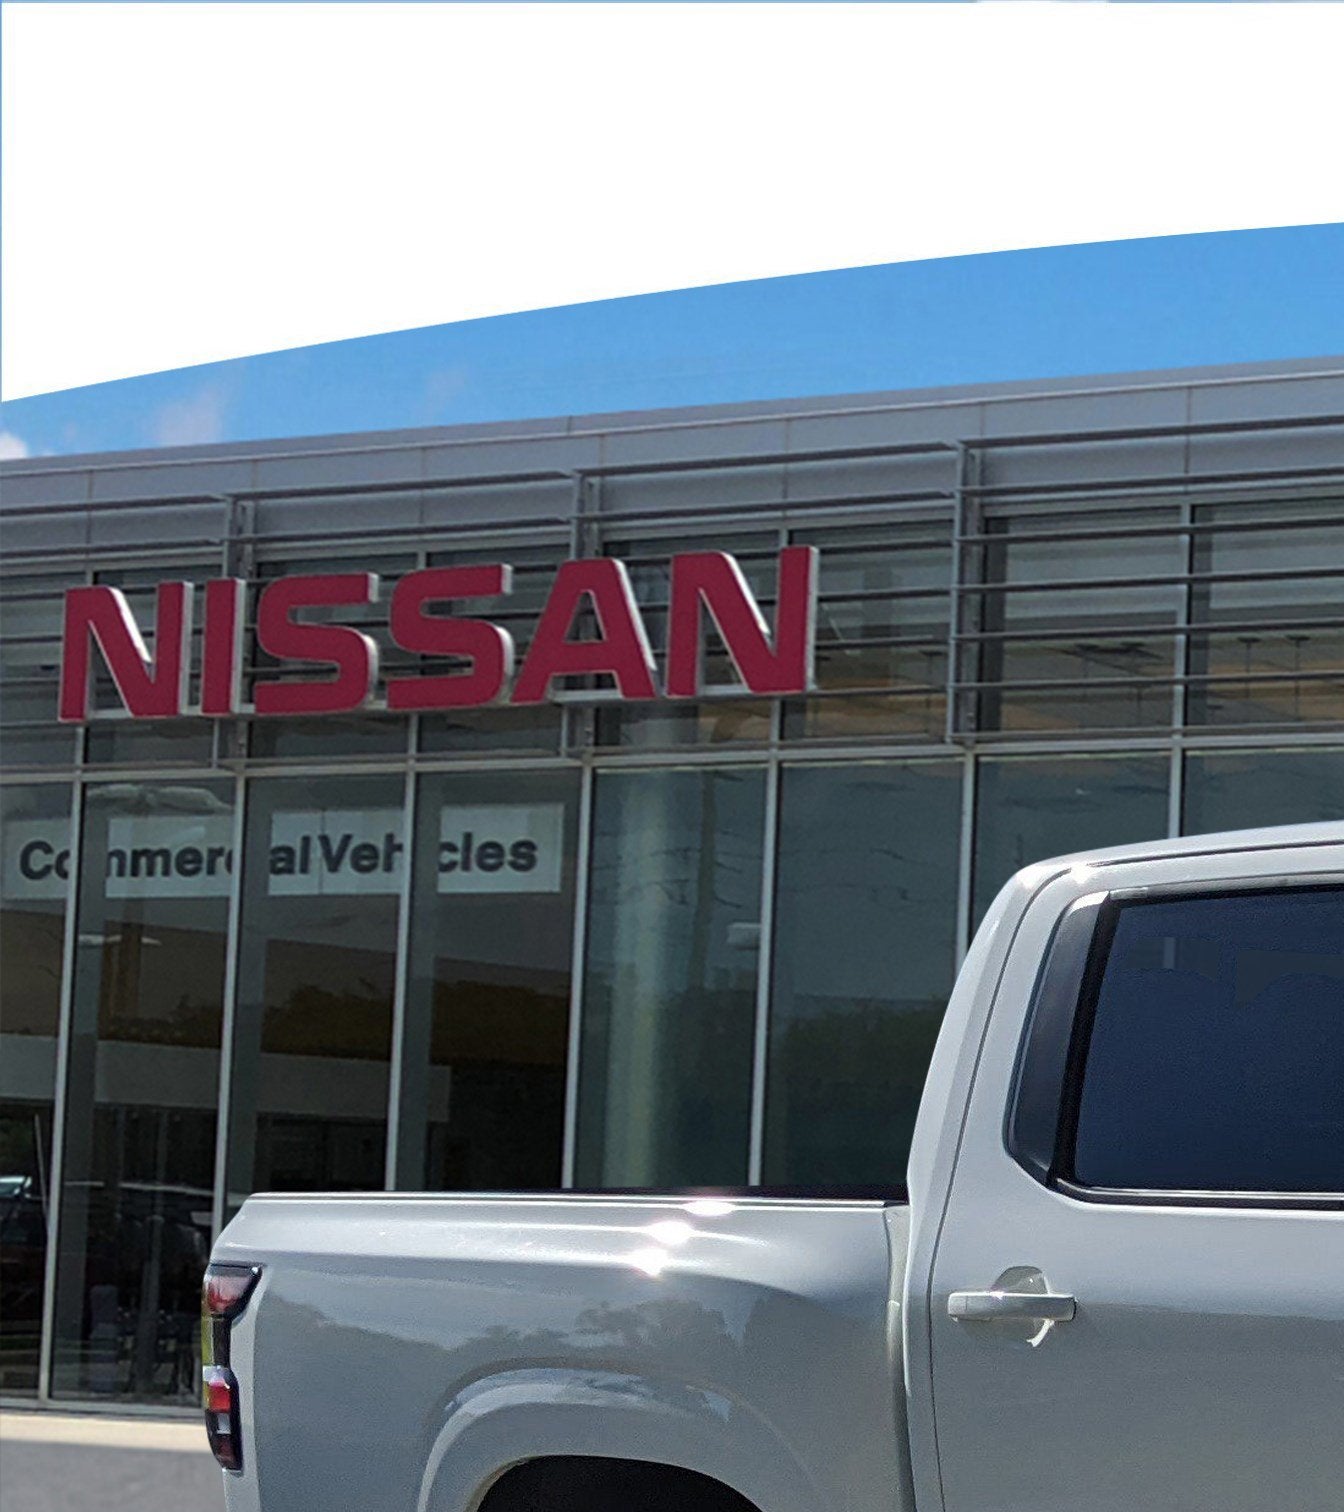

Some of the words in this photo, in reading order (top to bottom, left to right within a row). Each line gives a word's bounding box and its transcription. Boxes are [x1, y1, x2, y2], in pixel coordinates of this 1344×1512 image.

[58, 545, 820, 723] NISSAN
[20, 835, 311, 881] Comeral
[318, 831, 538, 874] Vehcles
